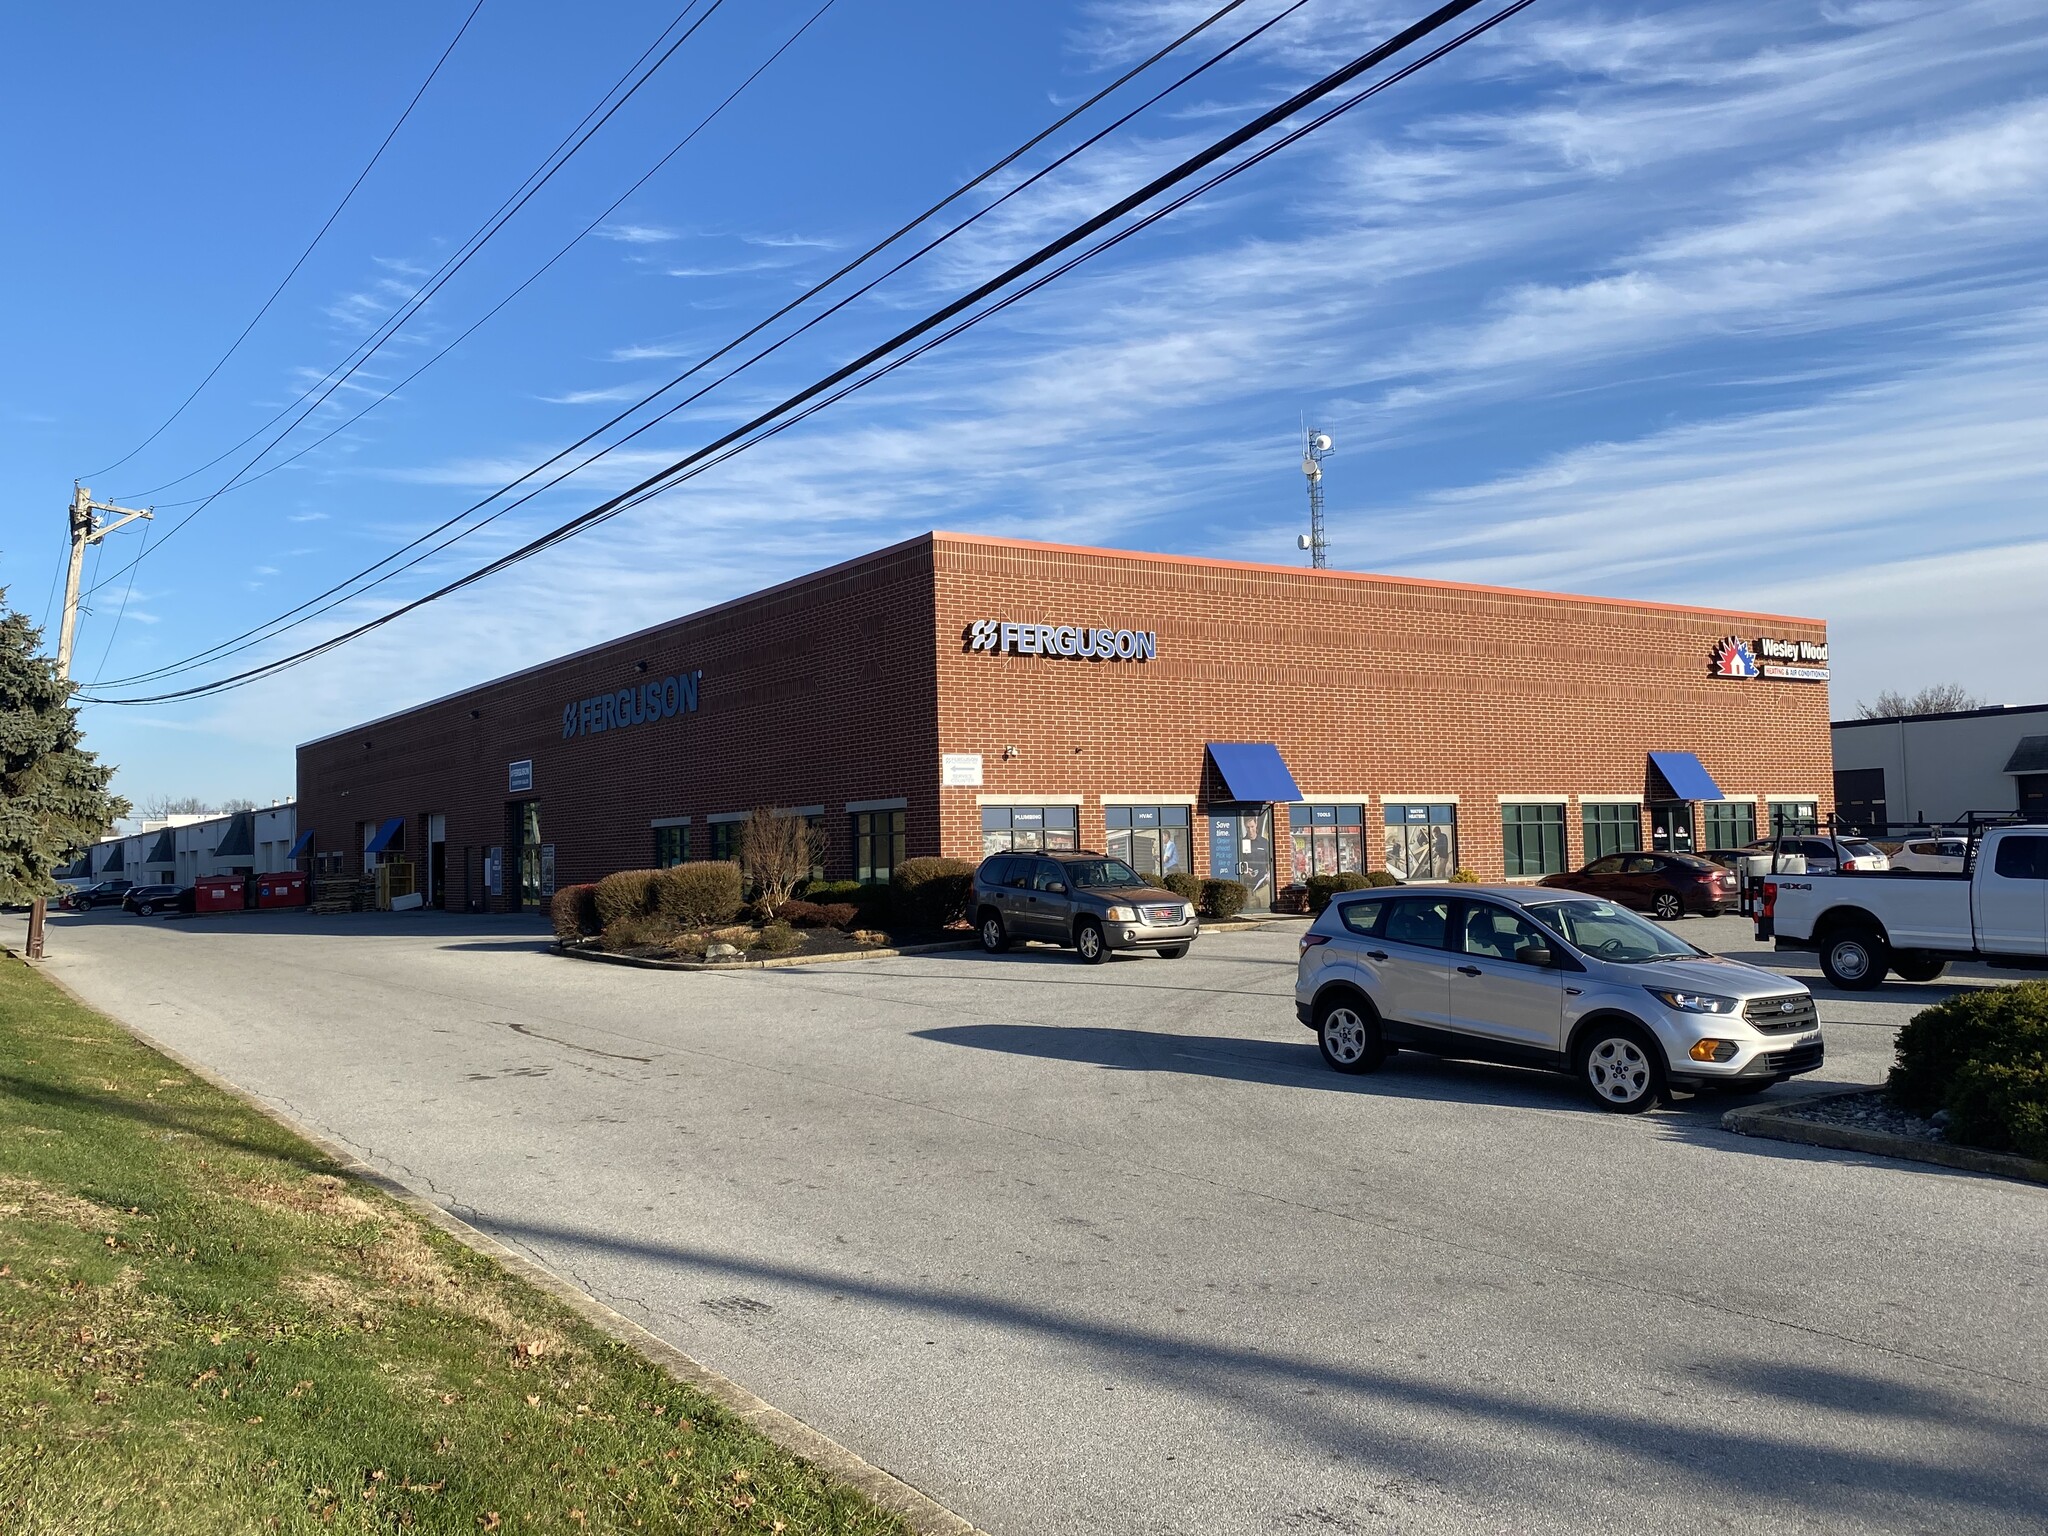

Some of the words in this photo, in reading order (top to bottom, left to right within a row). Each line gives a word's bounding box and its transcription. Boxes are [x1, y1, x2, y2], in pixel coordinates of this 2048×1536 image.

[1001, 622, 1156, 660] FERGUSON
[1762, 638, 1799, 662] Wesley
[1800, 641, 1828, 660] Wood
[1766, 667, 1785, 676] HEATING
[1798, 669, 1829, 678] CONDITIONING
[580, 671, 698, 736] FERGUSON
[1216, 821, 1230, 829] Save
